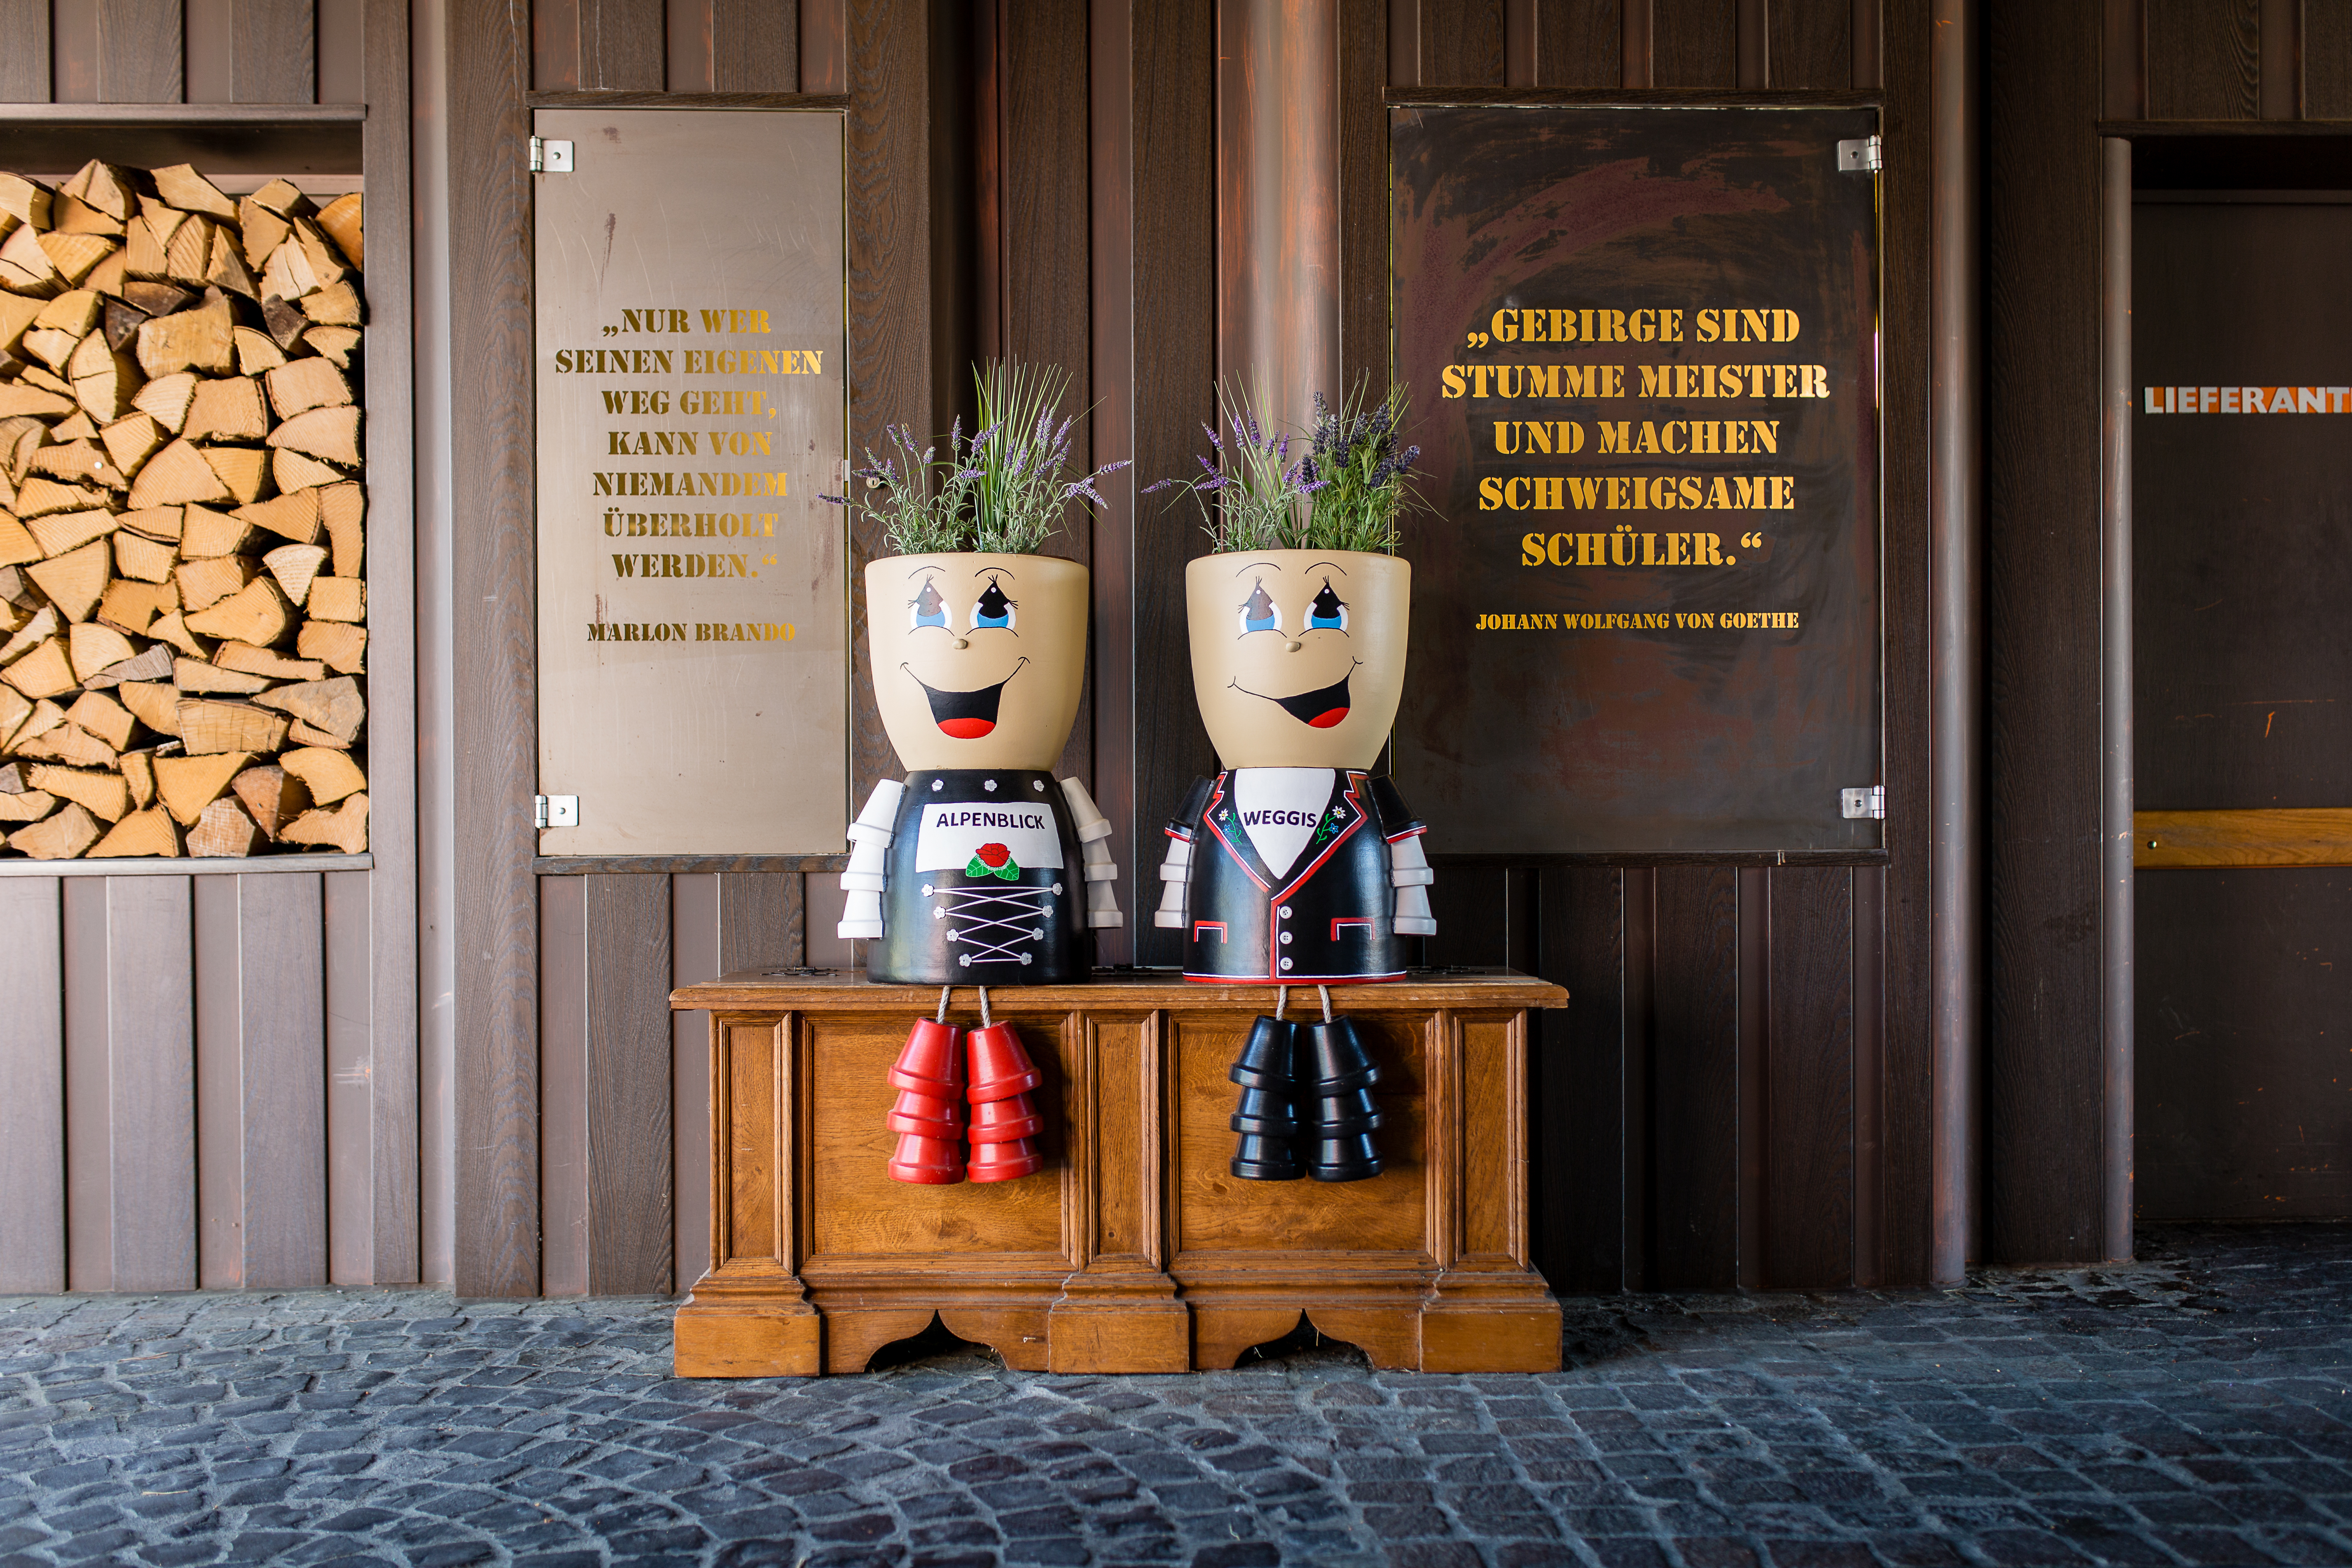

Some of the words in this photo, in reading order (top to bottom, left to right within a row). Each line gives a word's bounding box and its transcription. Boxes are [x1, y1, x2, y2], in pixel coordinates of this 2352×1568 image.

[603, 309, 690, 337] „NUR
[699, 309, 772, 334] WER
[1467, 309, 1683, 348] „GEBIRGE
[1696, 309, 1800, 342] SIND
[555, 350, 673, 374] SEINEN
[684, 350, 823, 374] EIGENEN
[1442, 365, 1625, 398] STUMME
[1638, 365, 1830, 398] MEISTER
[601, 390, 670, 415] WEG
[680, 391, 776, 419] GEHT,
[2144, 387, 2352, 414] LIEFERANT
[608, 432, 699, 456] KANN
[708, 432, 773, 456] VON
[1493, 421, 1585, 454] UND
[1597, 421, 1779, 454] MACHEN
[592, 472, 788, 496] NIEMANDEM
[1479, 476, 1794, 510] SCHWEIGSAME
[603, 507, 779, 537] ÜBERHOLT
[1522, 524, 1762, 566] SCHÜLER.“
[612, 554, 778, 578] WERDEN.“
[587, 623, 687, 642] MARLON
[695, 623, 795, 642] BRANDO
[1476, 614, 1557, 630] JOHANN
[1564, 613, 1669, 629] WOLFGANG
[1675, 613, 1714, 629] VON
[1720, 612, 1799, 629] GOETHE
[936, 812, 1045, 830] ALPENBLICK
[1243, 810, 1317, 828] WEGGIS
